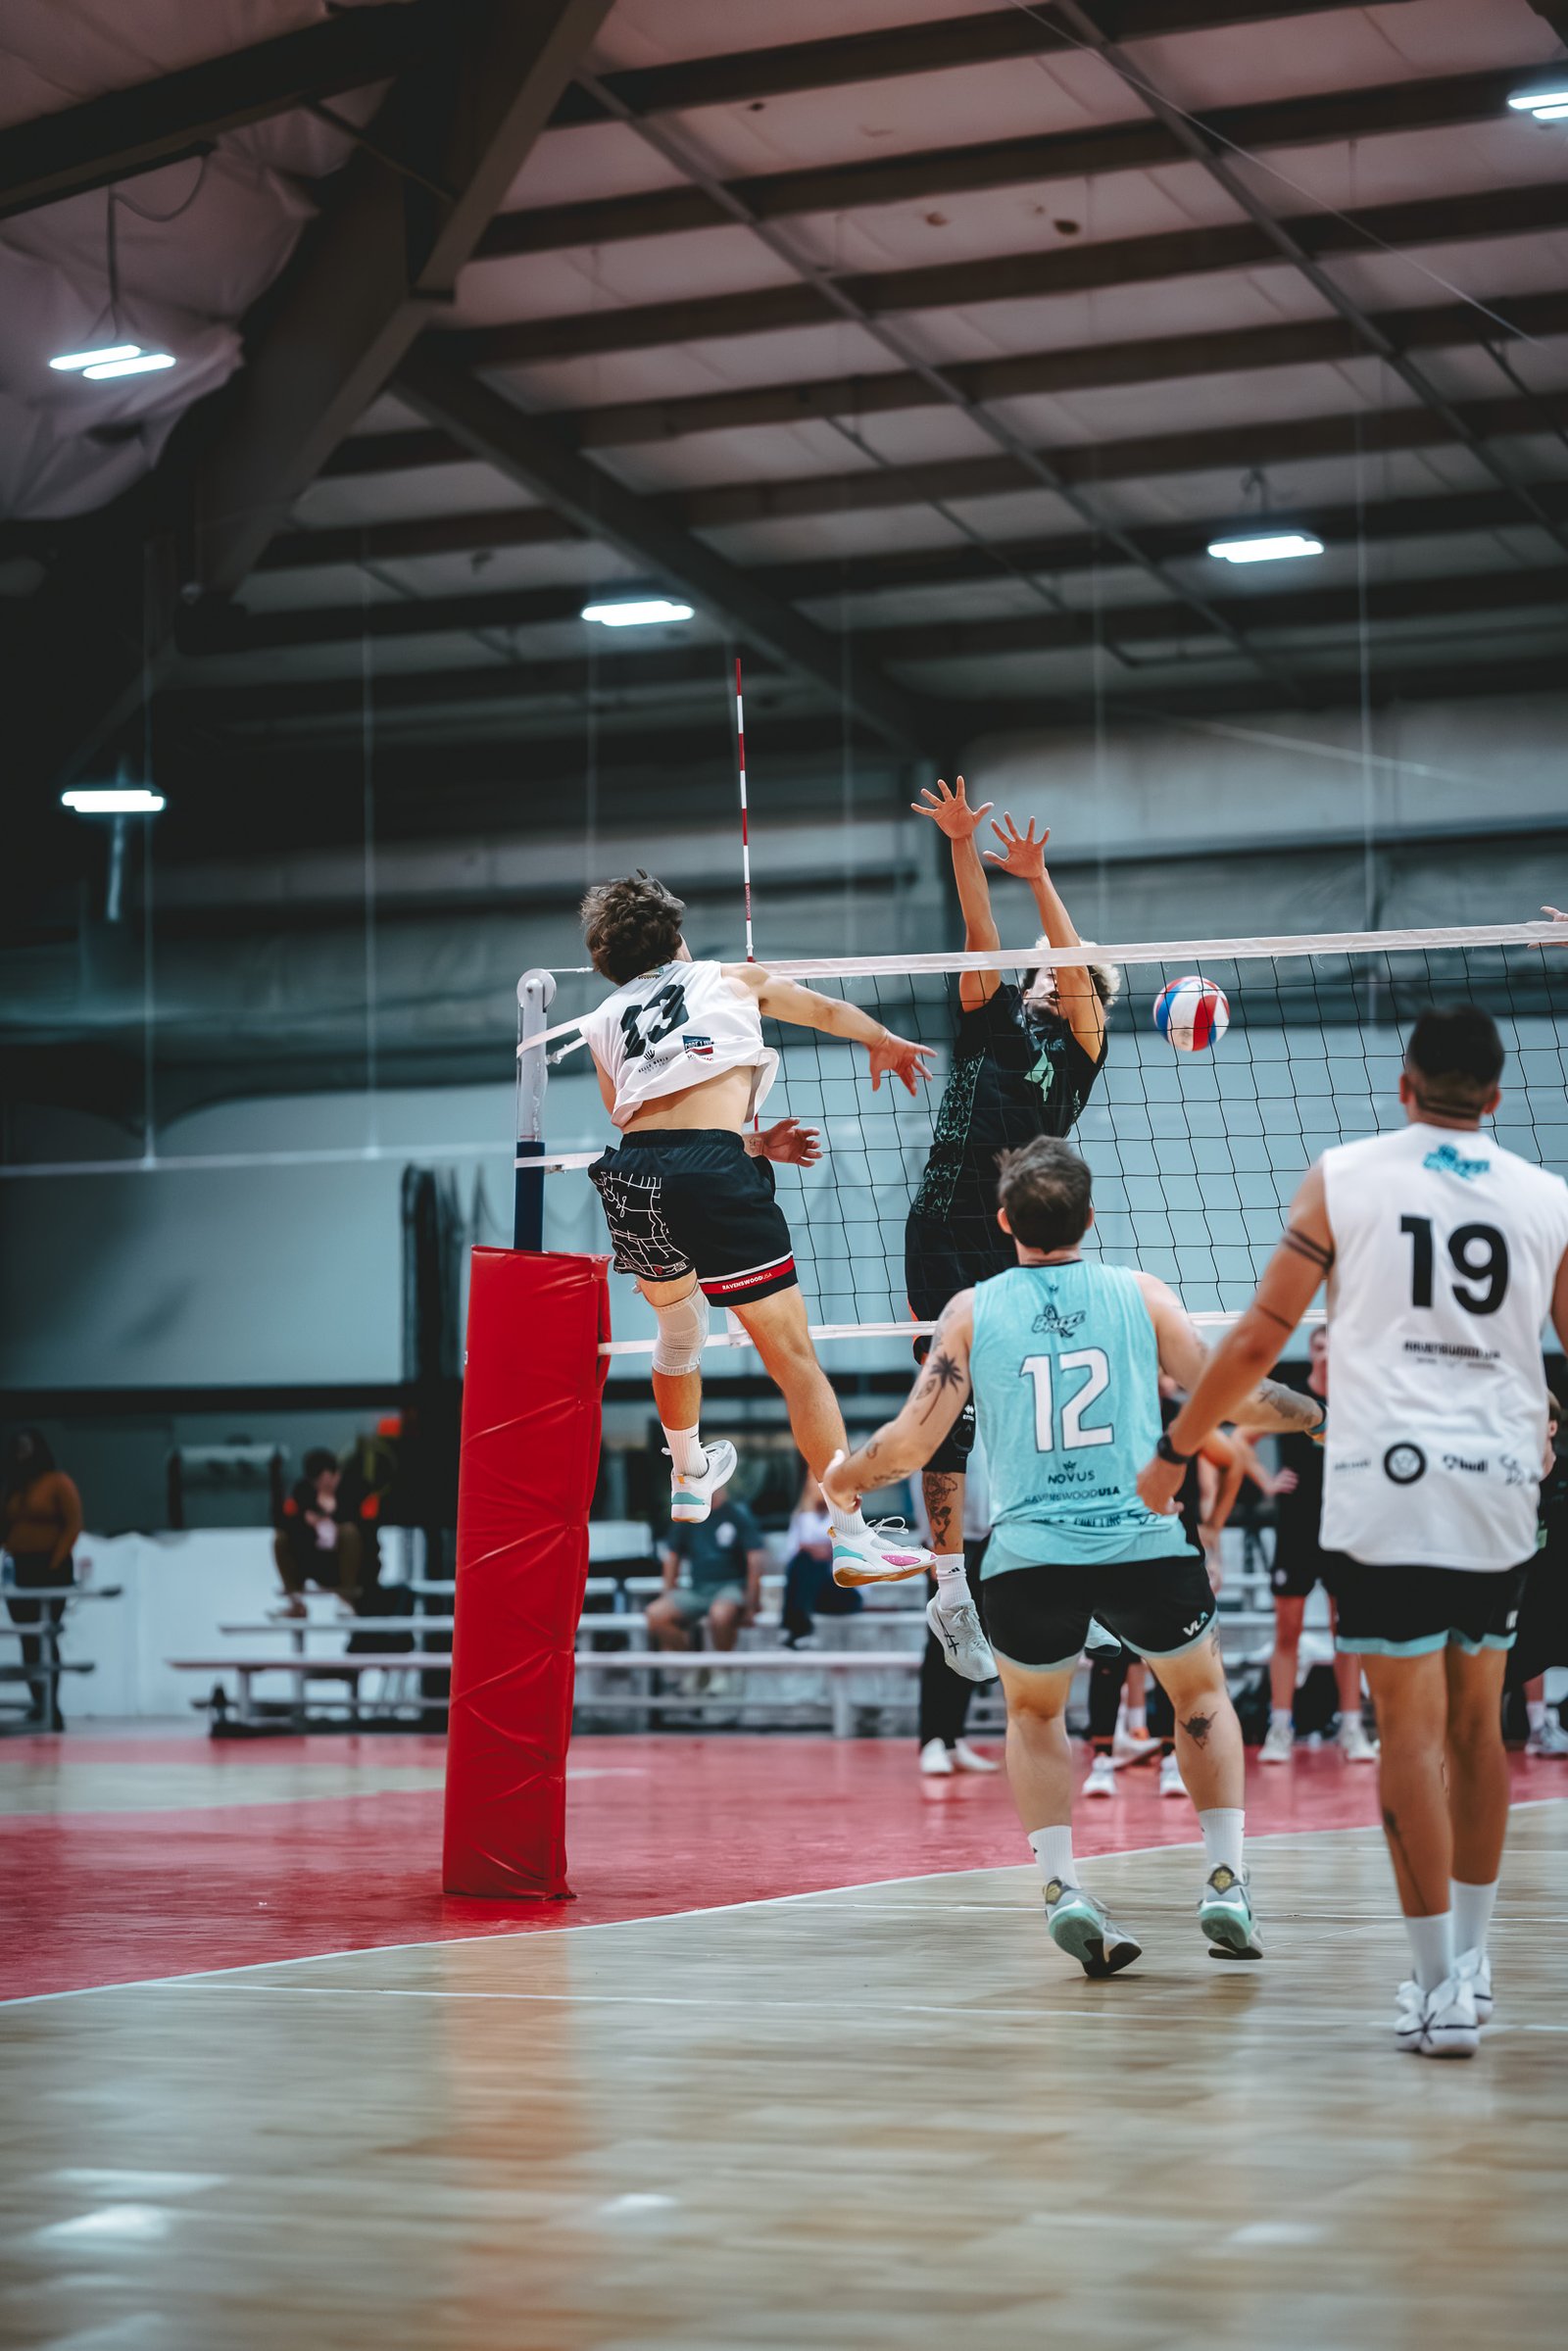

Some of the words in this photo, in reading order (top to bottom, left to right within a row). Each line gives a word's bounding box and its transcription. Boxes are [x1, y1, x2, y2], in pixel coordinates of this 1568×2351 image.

[1400, 1215, 1509, 1314] 19
[1019, 1347, 1114, 1453] 12
[1048, 1470, 1096, 1484] NOVUS
